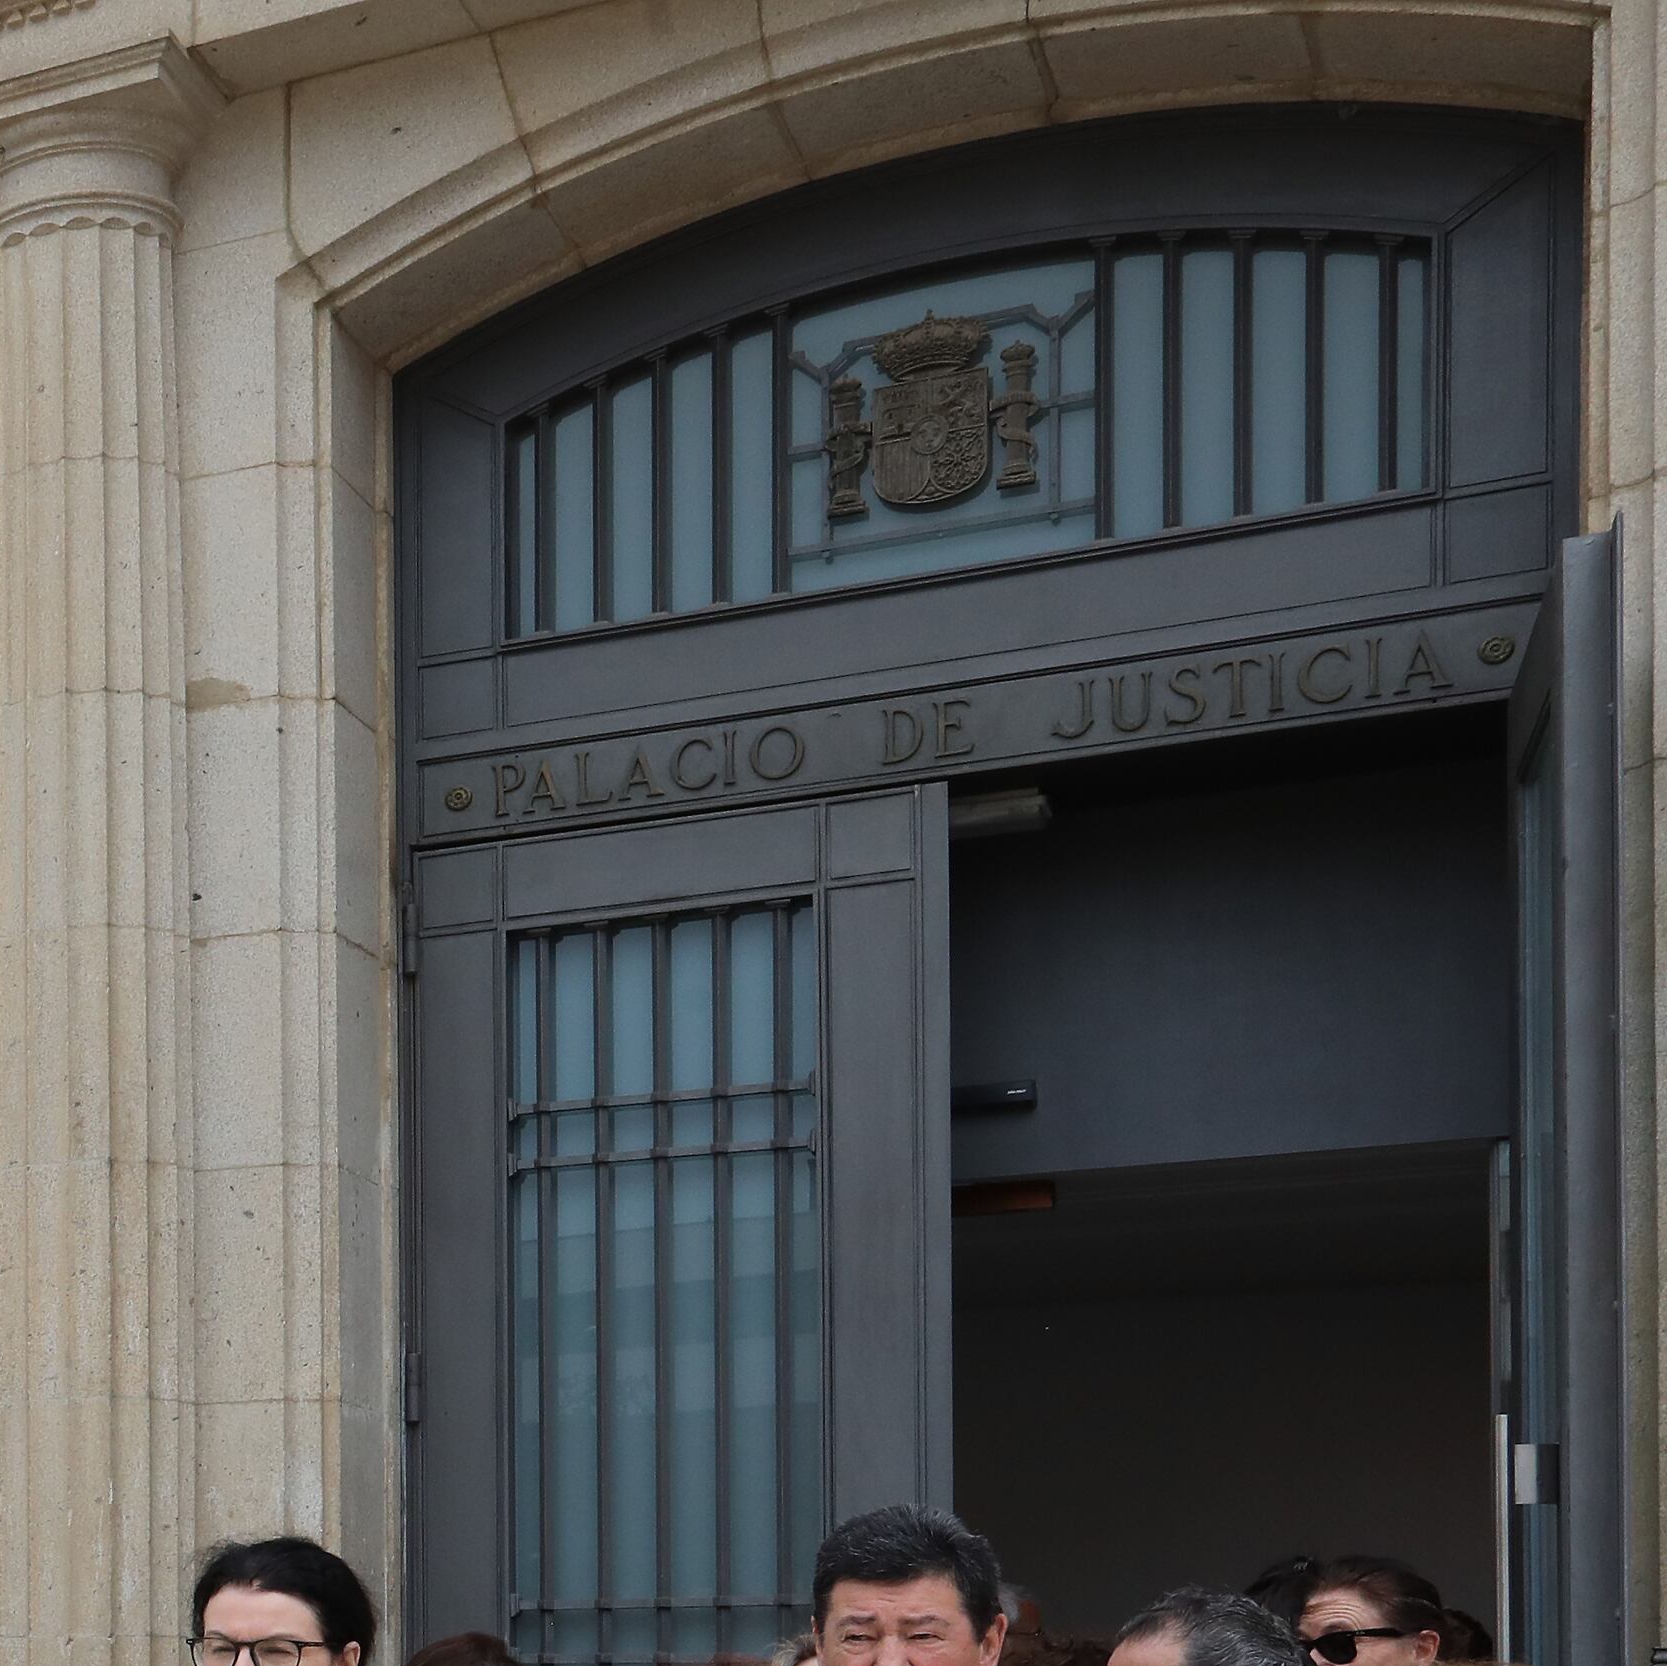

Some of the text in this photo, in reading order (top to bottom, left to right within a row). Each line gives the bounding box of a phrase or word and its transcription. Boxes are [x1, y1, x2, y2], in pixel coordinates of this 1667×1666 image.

[491, 629, 1454, 818] PALACIO DE JUSTICIA
